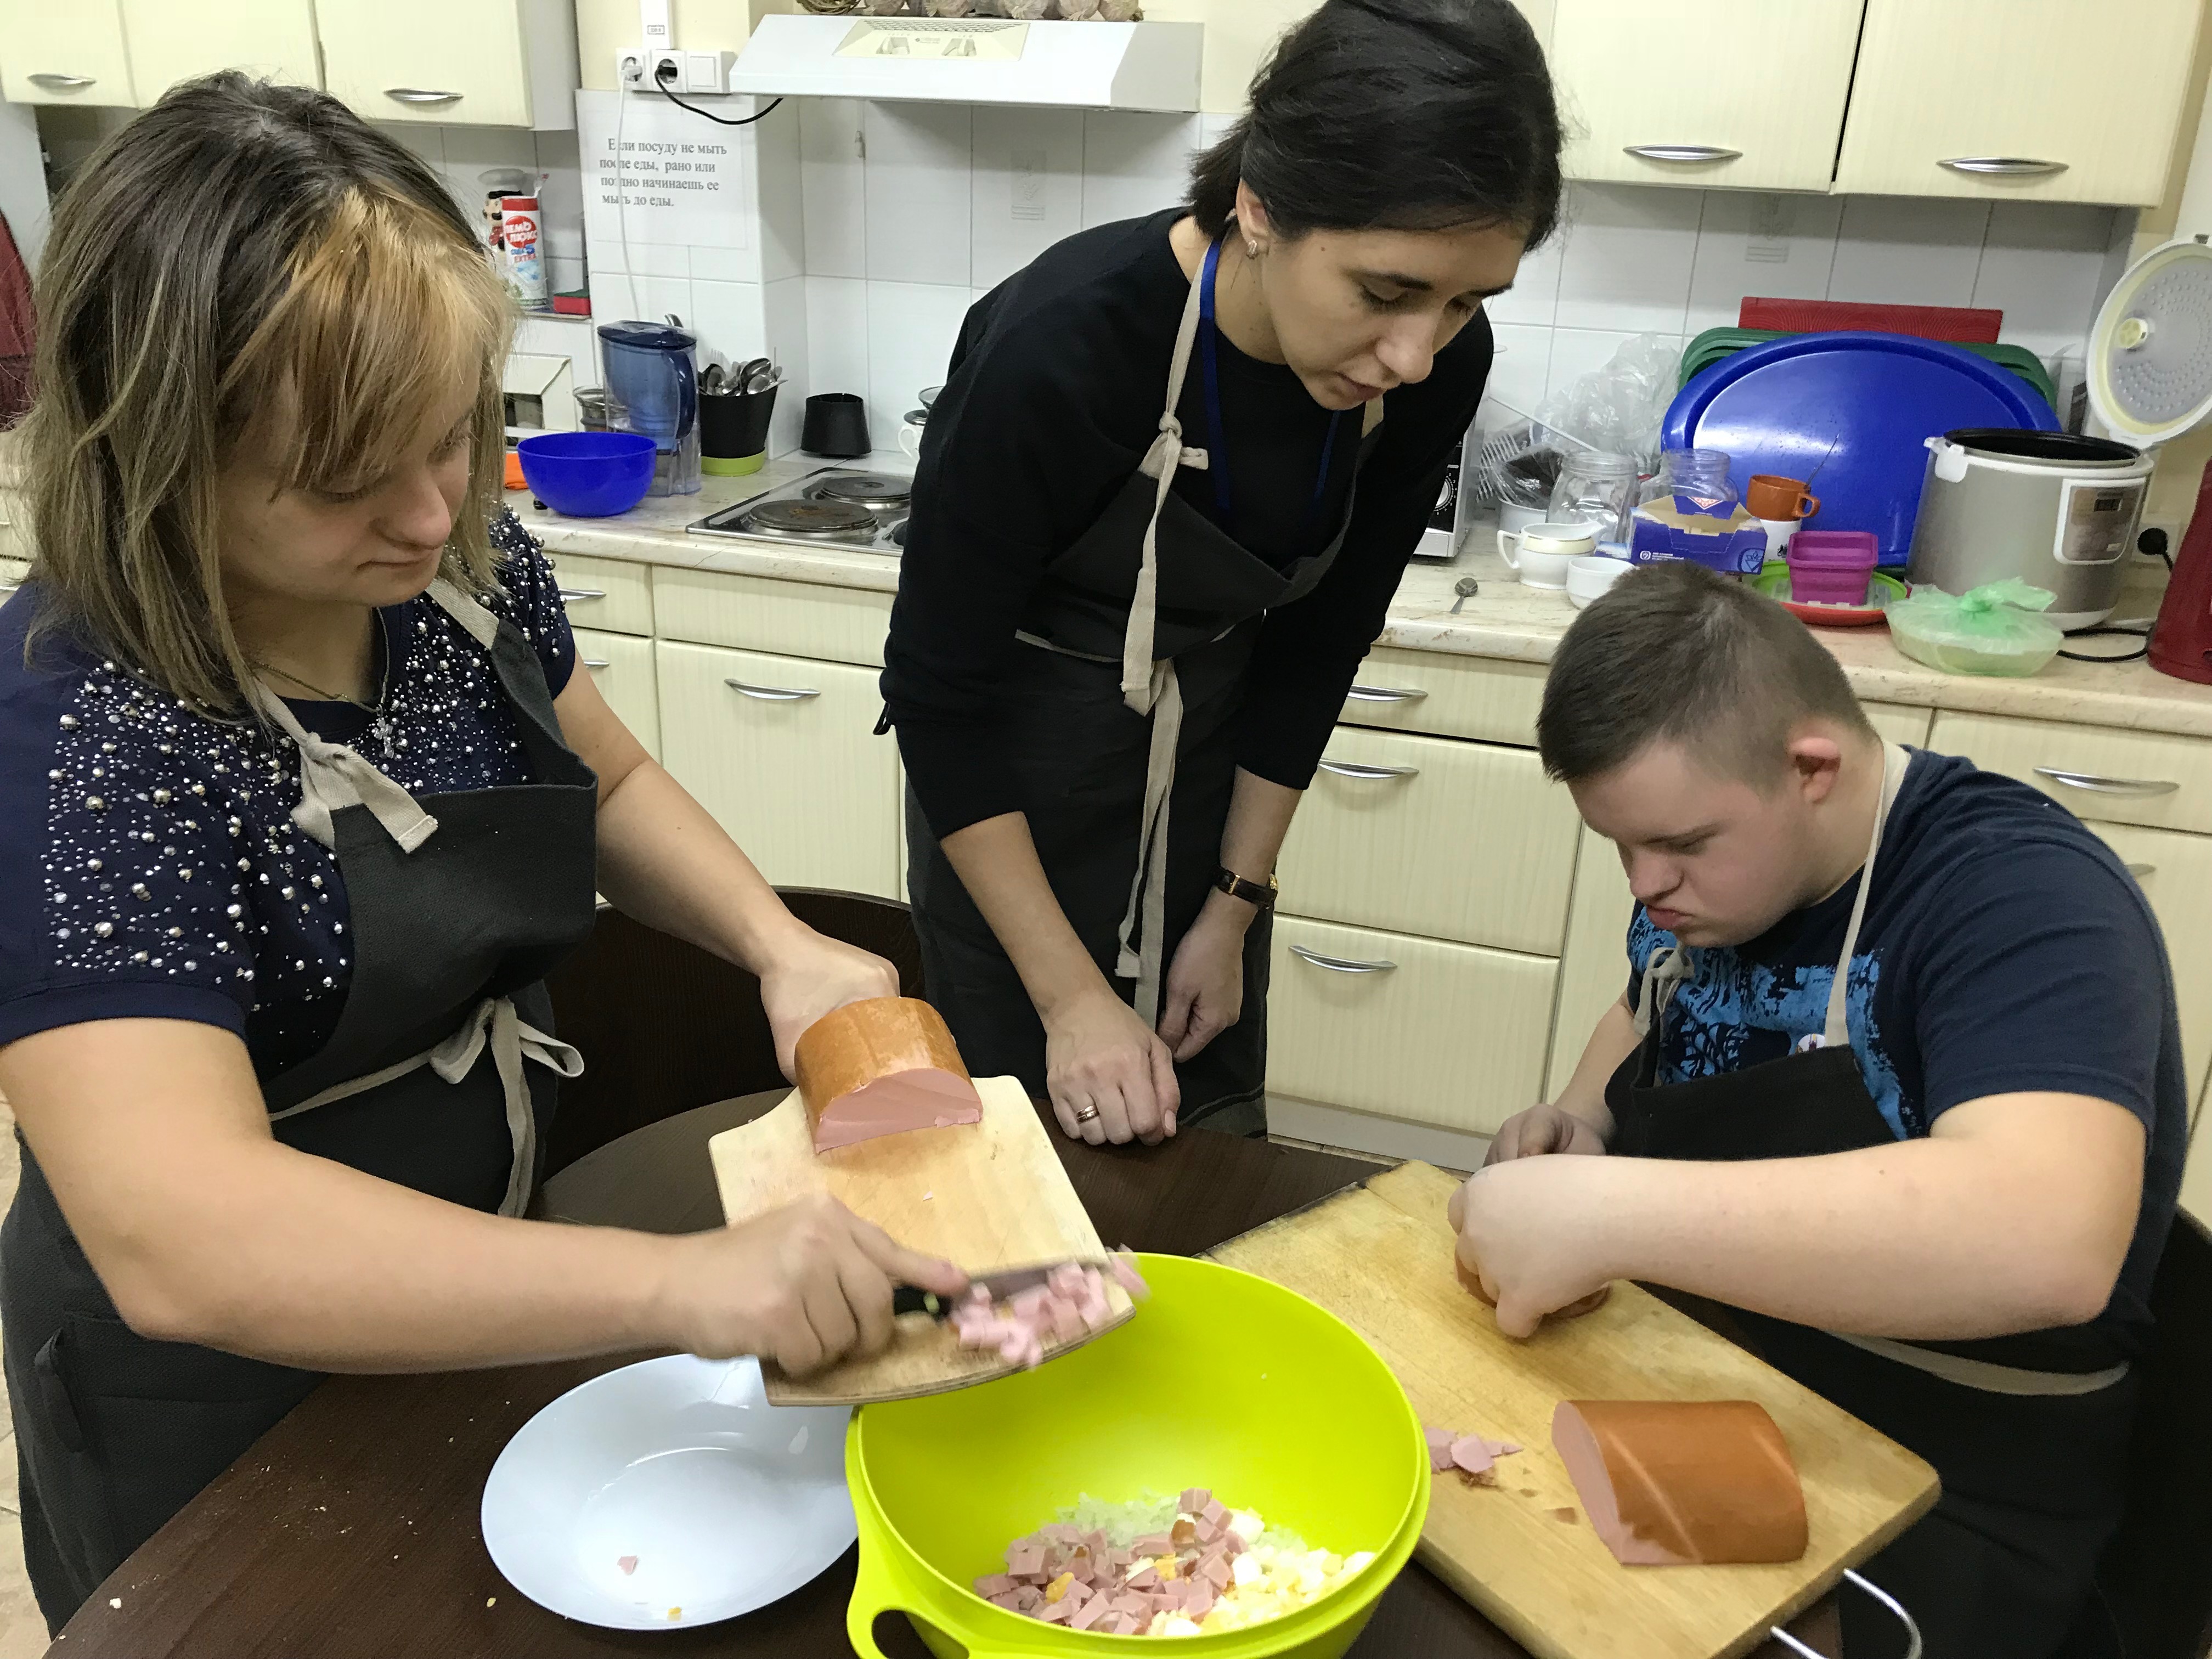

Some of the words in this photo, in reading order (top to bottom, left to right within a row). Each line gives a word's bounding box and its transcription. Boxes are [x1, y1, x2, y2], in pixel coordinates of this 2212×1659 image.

[607, 138, 635, 151] Ели
[638, 142, 678, 155] посуду
[681, 144, 695, 153] не
[697, 145, 727, 154] мыть
[633, 160, 659, 172] еды,
[664, 162, 692, 174] рано
[695, 163, 716, 172] или
[600, 177, 640, 187] подно
[642, 179, 704, 190] начинаешь
[707, 182, 720, 190] ее
[633, 196, 647, 206] до
[649, 196, 675, 207] еды.
